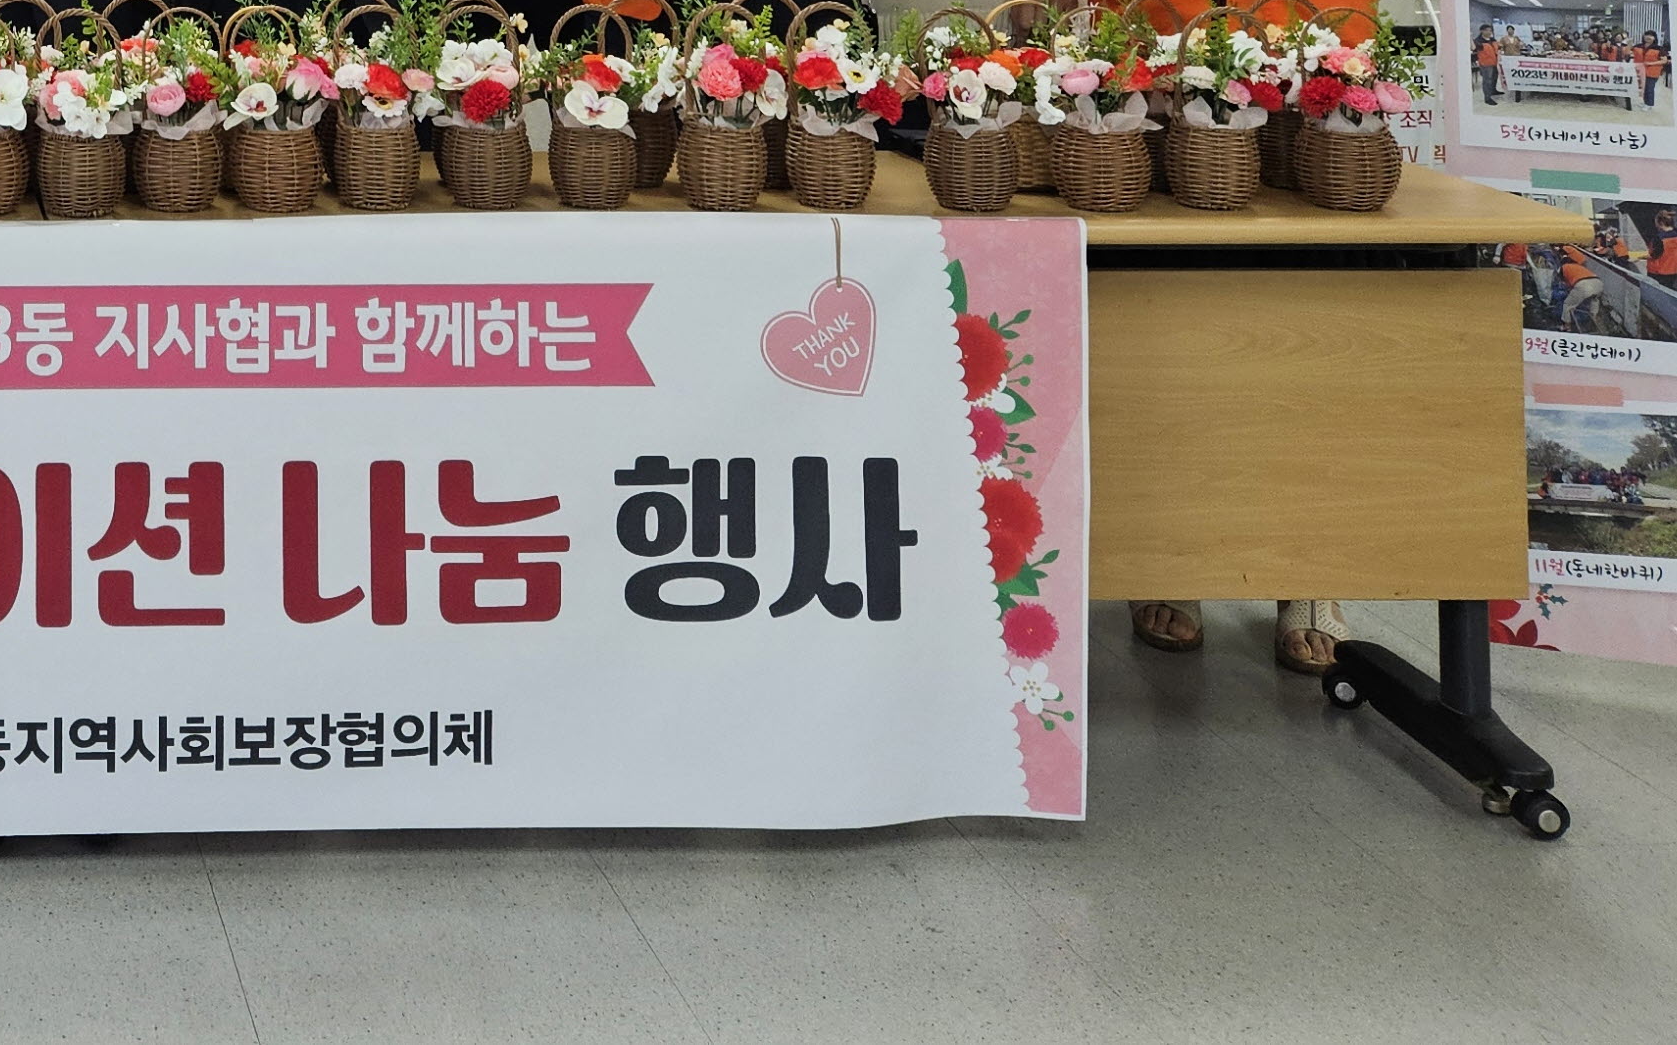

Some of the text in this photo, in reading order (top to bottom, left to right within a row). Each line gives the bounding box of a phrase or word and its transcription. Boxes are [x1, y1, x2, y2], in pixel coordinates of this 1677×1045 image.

[1500, 125, 1648, 150] 5월(카네이션 나눔)
[93, 297, 337, 374] 지사협과
[354, 296, 598, 374] 함께하는
[792, 312, 856, 360] THANK
[813, 336, 860, 377] YOU
[281, 459, 572, 626] 나눔
[612, 455, 920, 623] 행사
